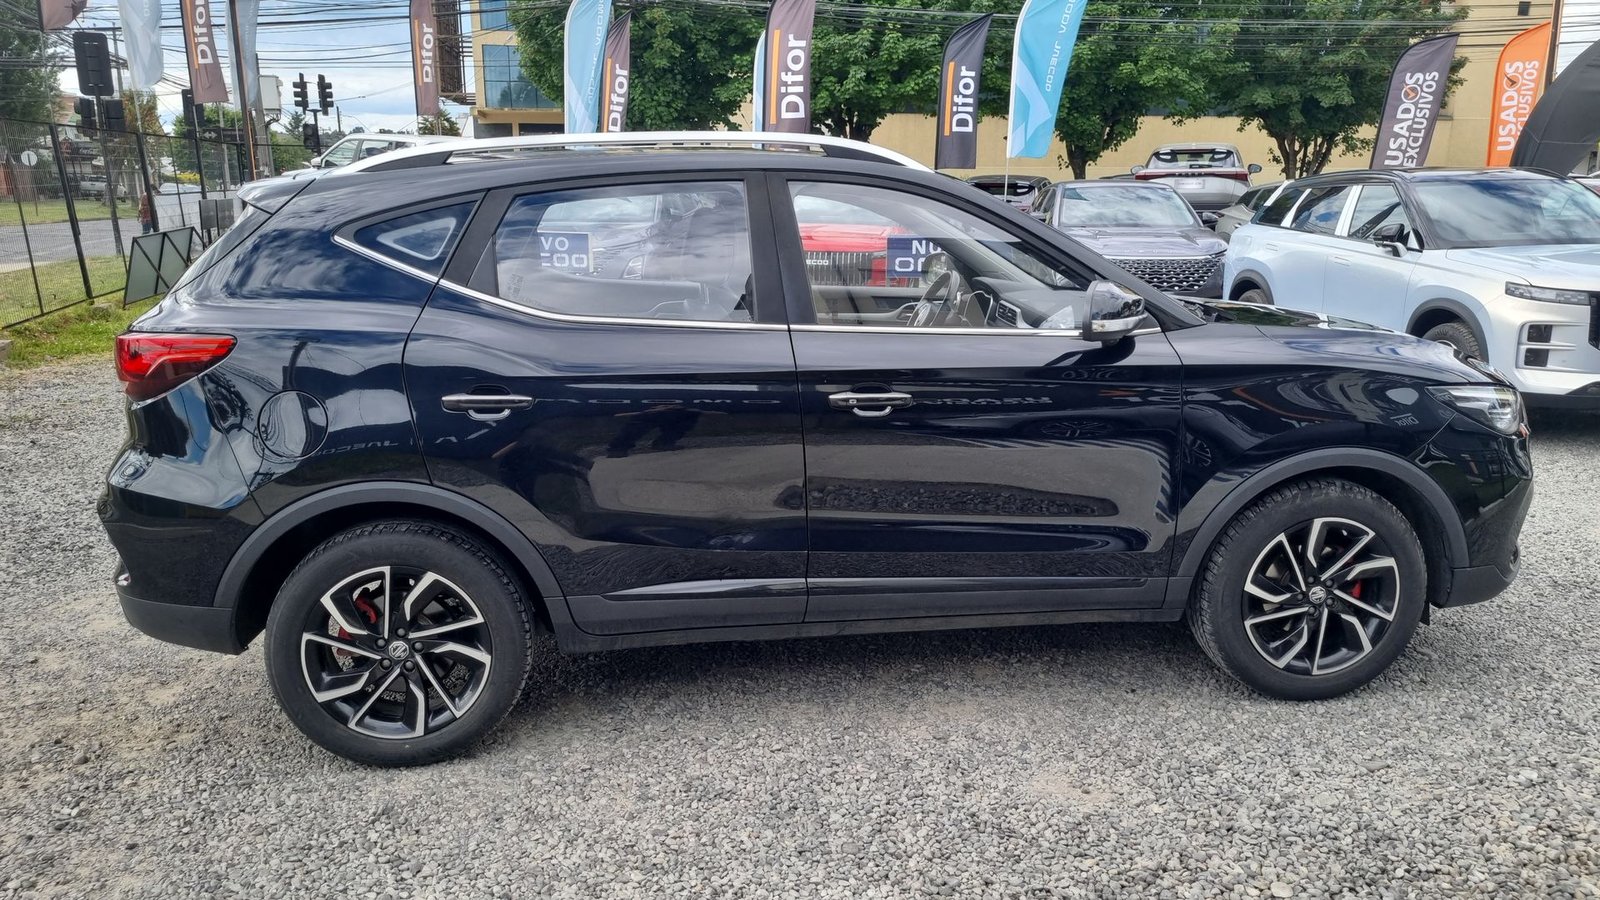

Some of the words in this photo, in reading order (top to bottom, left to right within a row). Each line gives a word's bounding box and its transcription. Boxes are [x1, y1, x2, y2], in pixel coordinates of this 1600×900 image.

[421, 23, 433, 82] Difor
[780, 34, 807, 119] Difor
[608, 64, 628, 131] Difor
[952, 66, 976, 132] Difor
[1384, 72, 1424, 166] USADOS
[1403, 71, 1439, 168] EXCLUSIVOS
[1497, 61, 1524, 151] USADOS
[1518, 60, 1539, 135] CLUSIVOS
